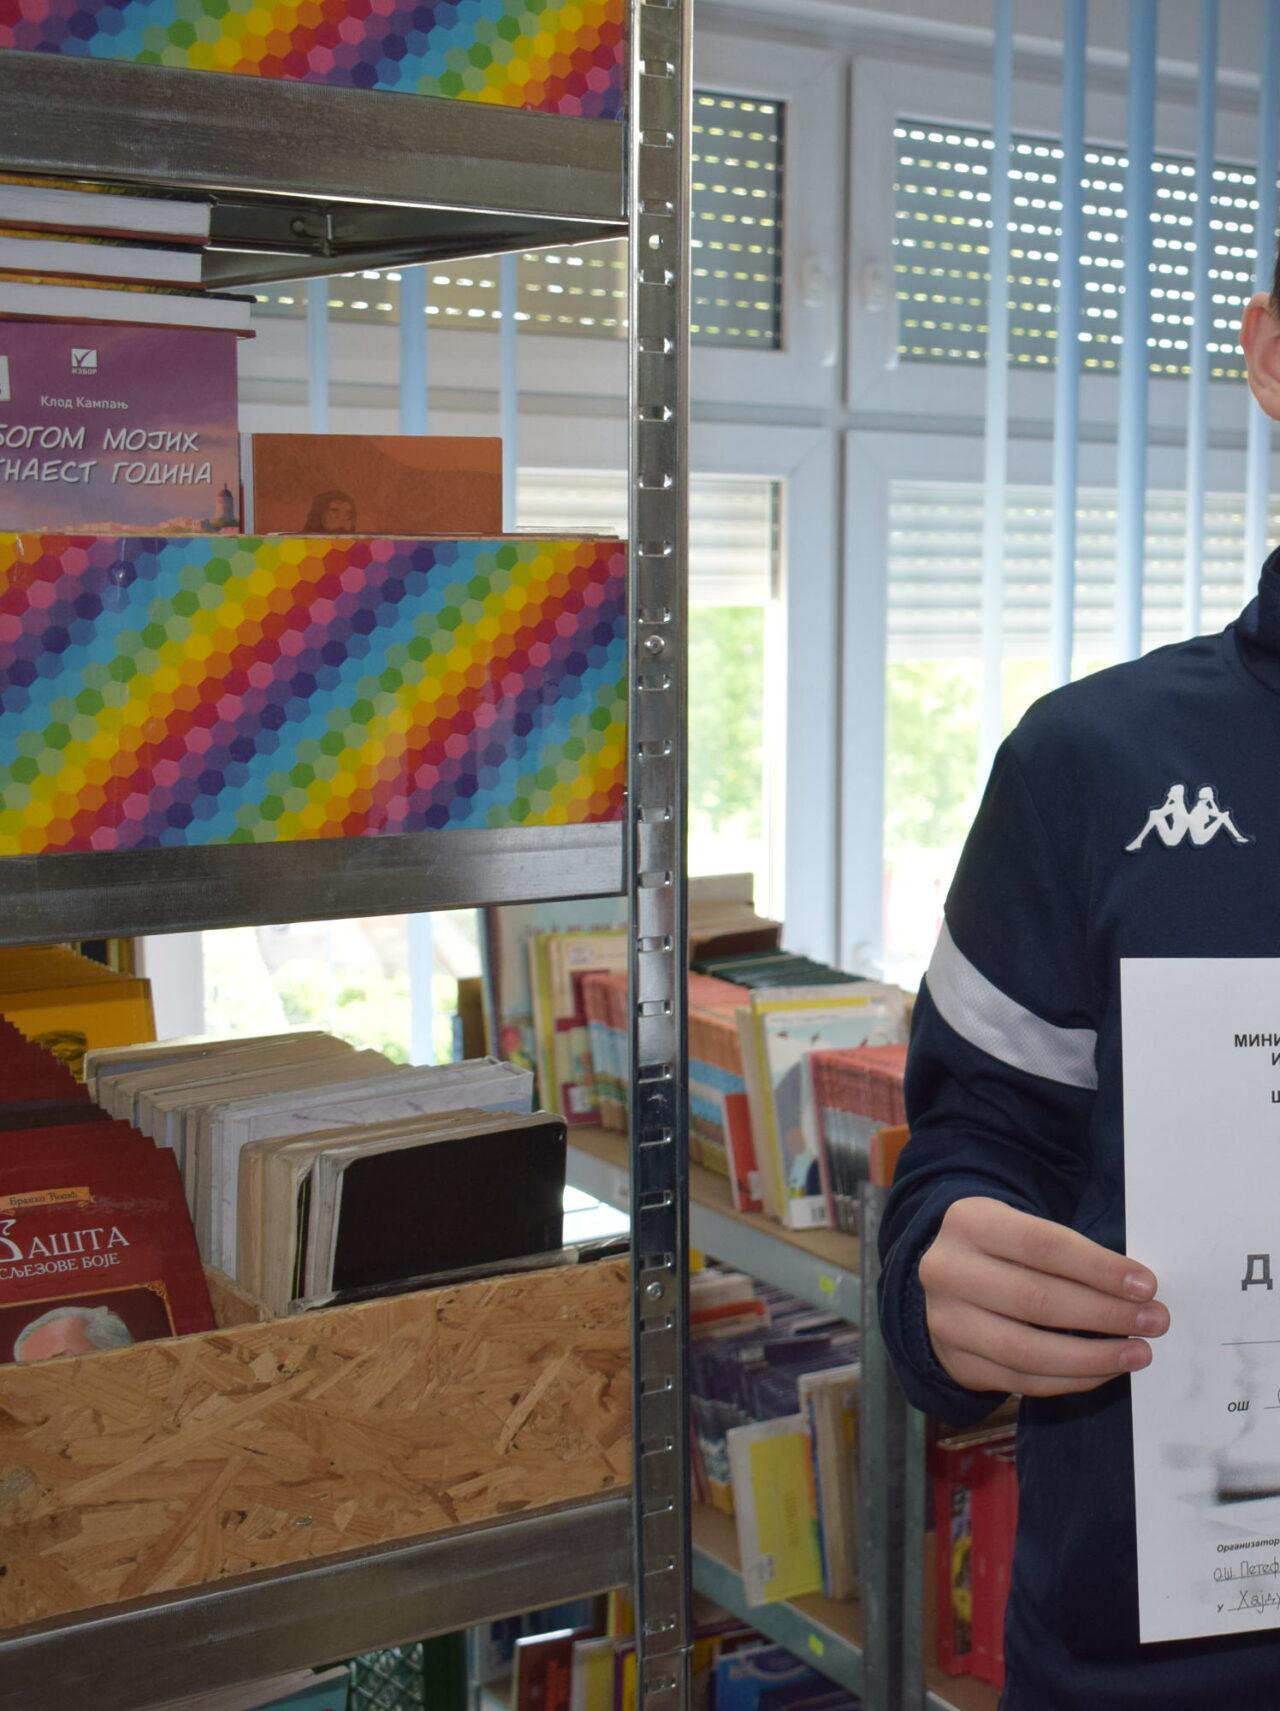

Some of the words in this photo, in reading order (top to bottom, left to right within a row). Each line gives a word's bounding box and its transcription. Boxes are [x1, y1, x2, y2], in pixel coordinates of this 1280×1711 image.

[41, 396, 73, 409] Клод
[76, 397, 128, 410] Кампањ
[103, 428, 199, 452] МОЈИХ
[111, 461, 212, 484] ГОДИНА
[82, 1253, 120, 1269] БОЈЕ
[1227, 1401, 1250, 1412] ОШ
[1216, 1538, 1280, 1553] Организатор
